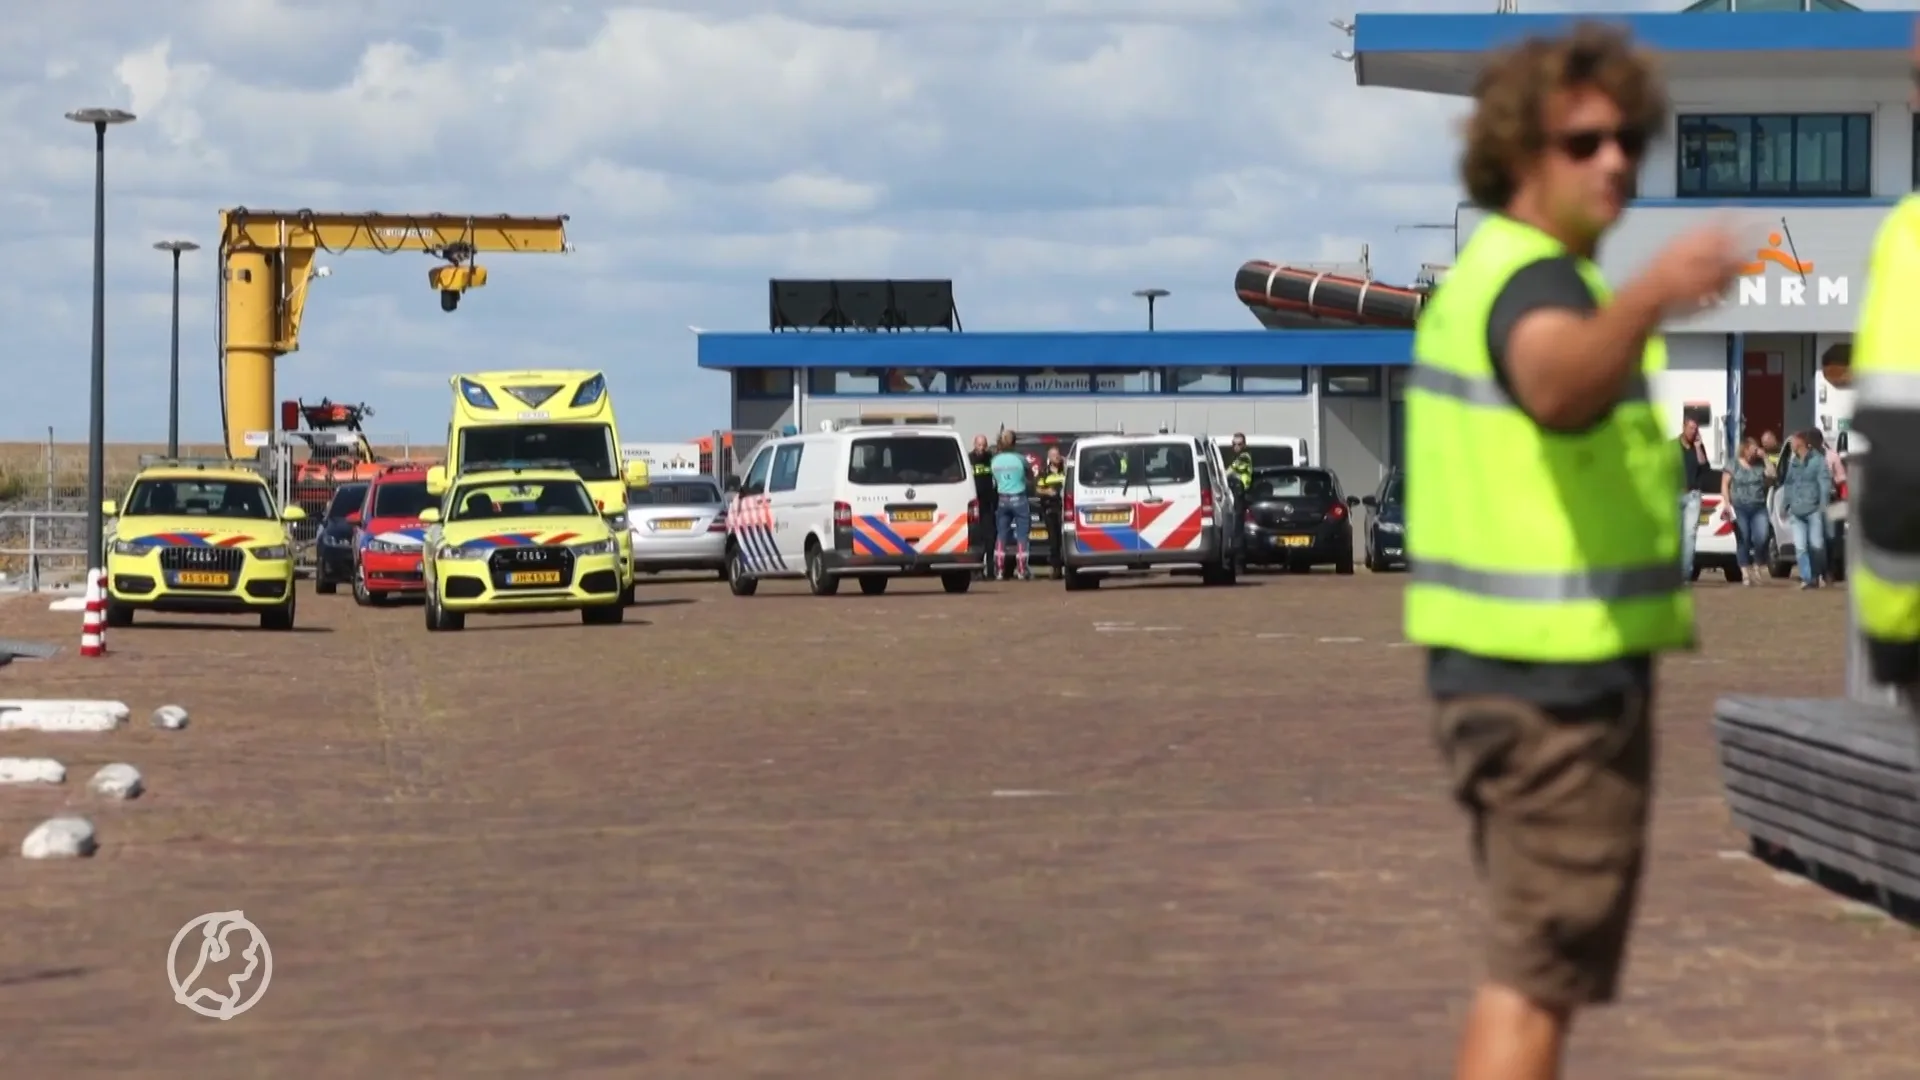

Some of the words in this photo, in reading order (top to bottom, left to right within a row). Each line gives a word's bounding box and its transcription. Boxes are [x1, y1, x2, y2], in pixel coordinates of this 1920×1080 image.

[1699, 276, 1848, 305] NRM
[963, 378, 1116, 391] ww.knr.nl/harlinen
[662, 462, 695, 470] KNRM
